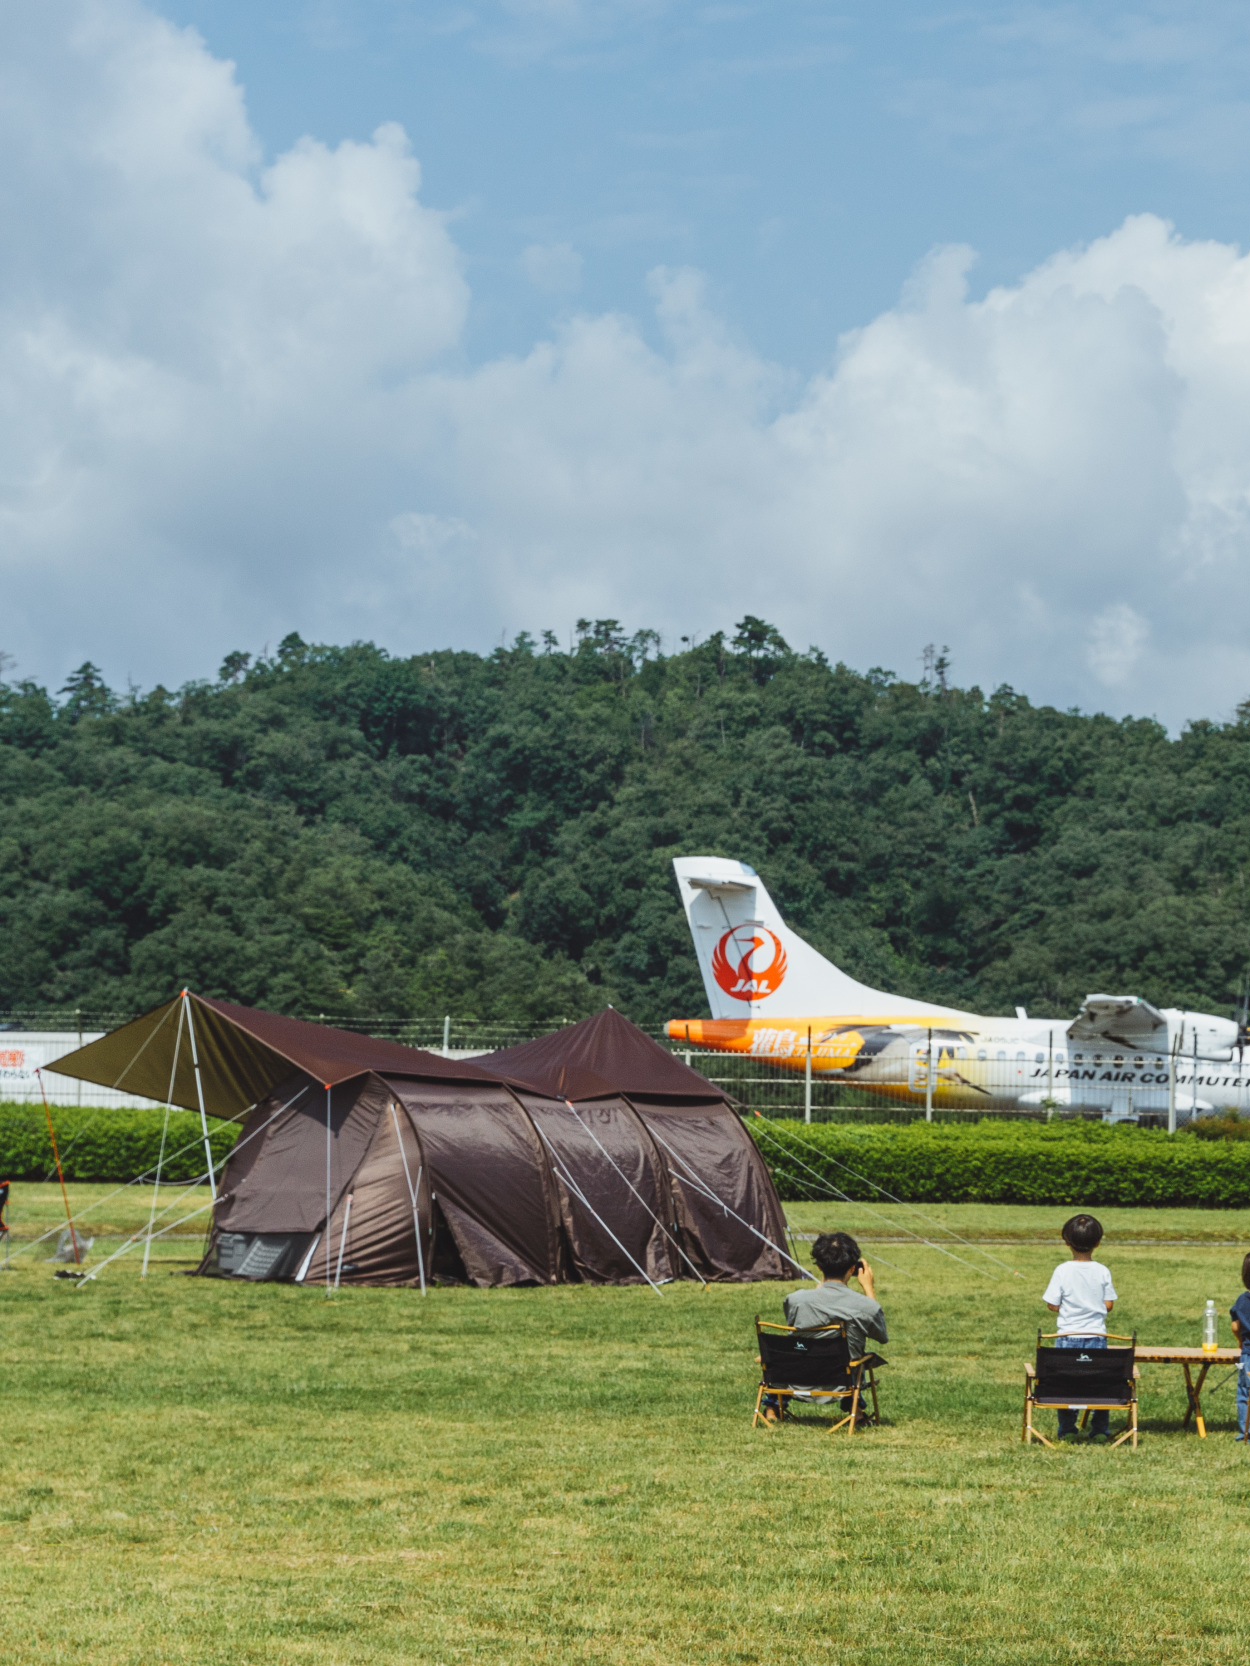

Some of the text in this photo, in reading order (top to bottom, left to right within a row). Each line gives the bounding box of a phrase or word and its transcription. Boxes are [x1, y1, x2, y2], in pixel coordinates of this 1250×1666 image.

[730, 979, 772, 993] JAL
[1030, 1068, 1096, 1081] JAPAN
[1099, 1071, 1135, 1083] AIR
